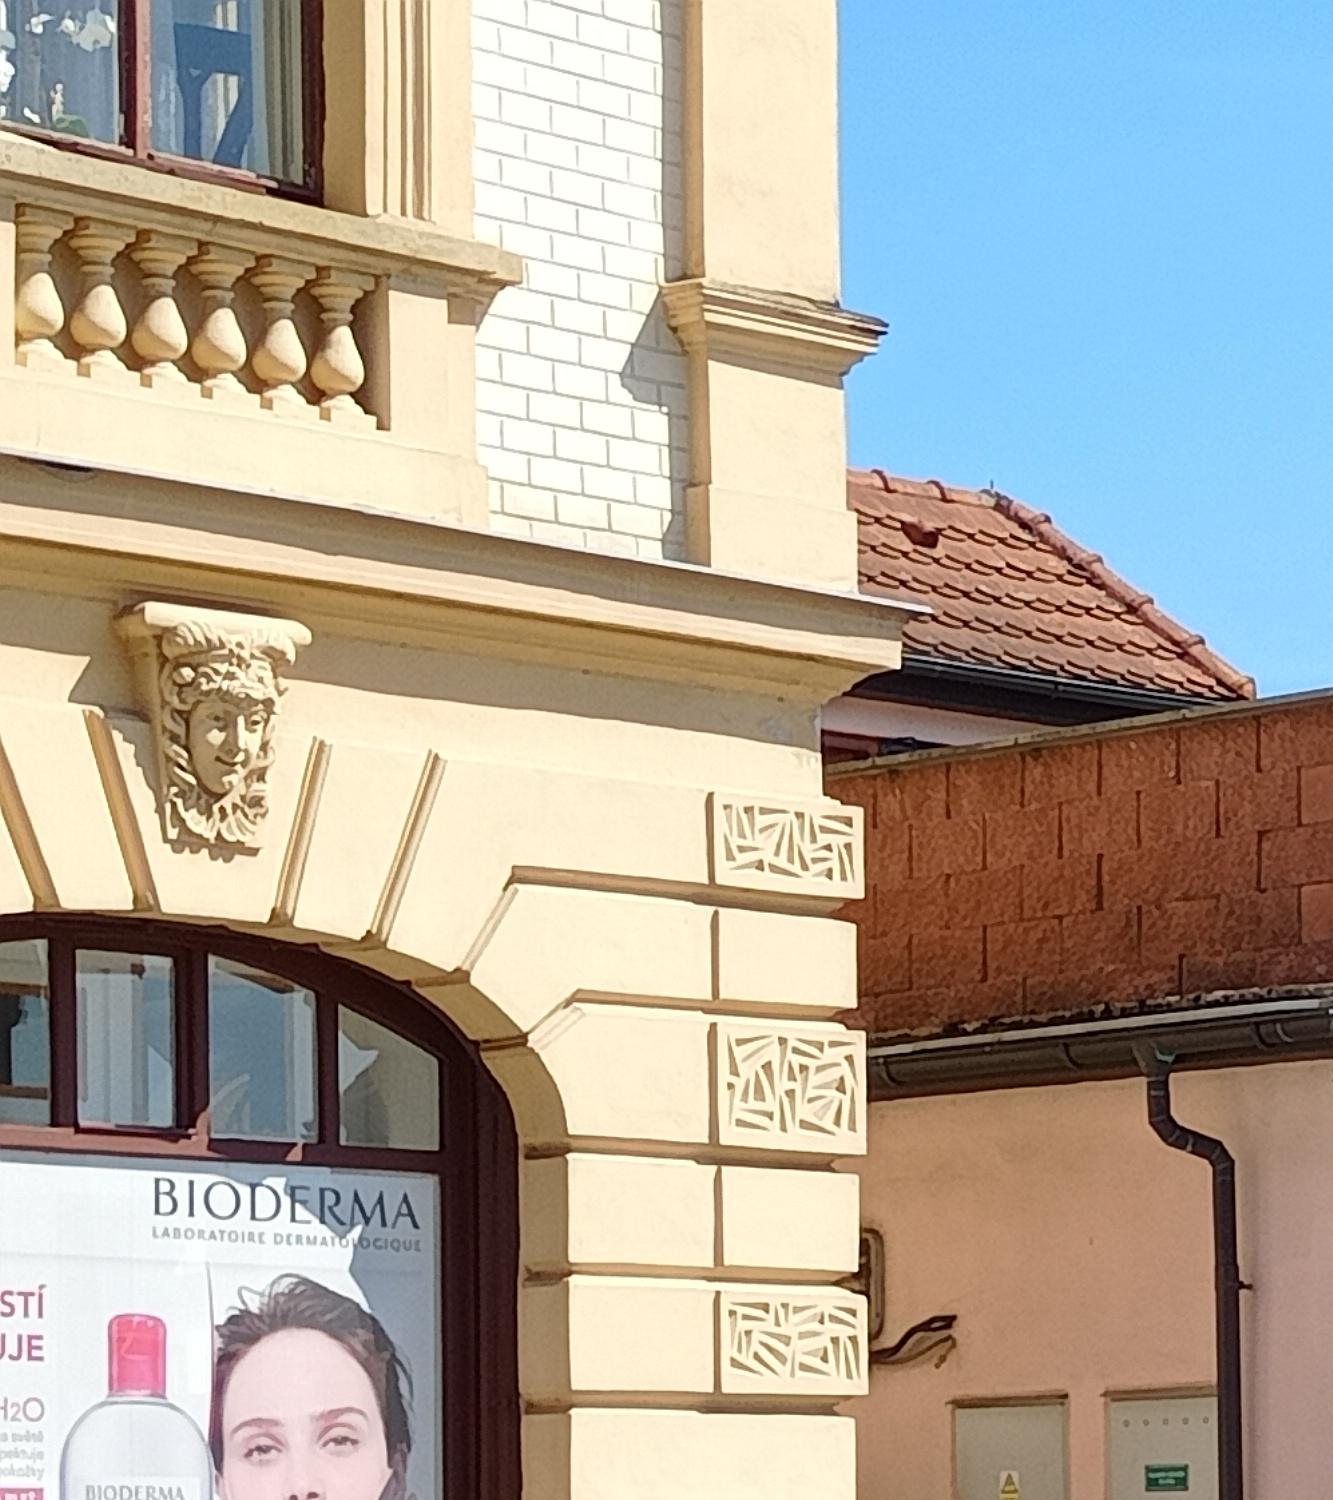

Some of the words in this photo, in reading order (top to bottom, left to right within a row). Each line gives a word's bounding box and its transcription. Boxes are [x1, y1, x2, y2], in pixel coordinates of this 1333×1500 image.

[154, 1177, 421, 1230] BIODERMA
[152, 1226, 266, 1245] LABORATOIRE
[273, 1232, 422, 1252] DERMATOLOGIQUE
